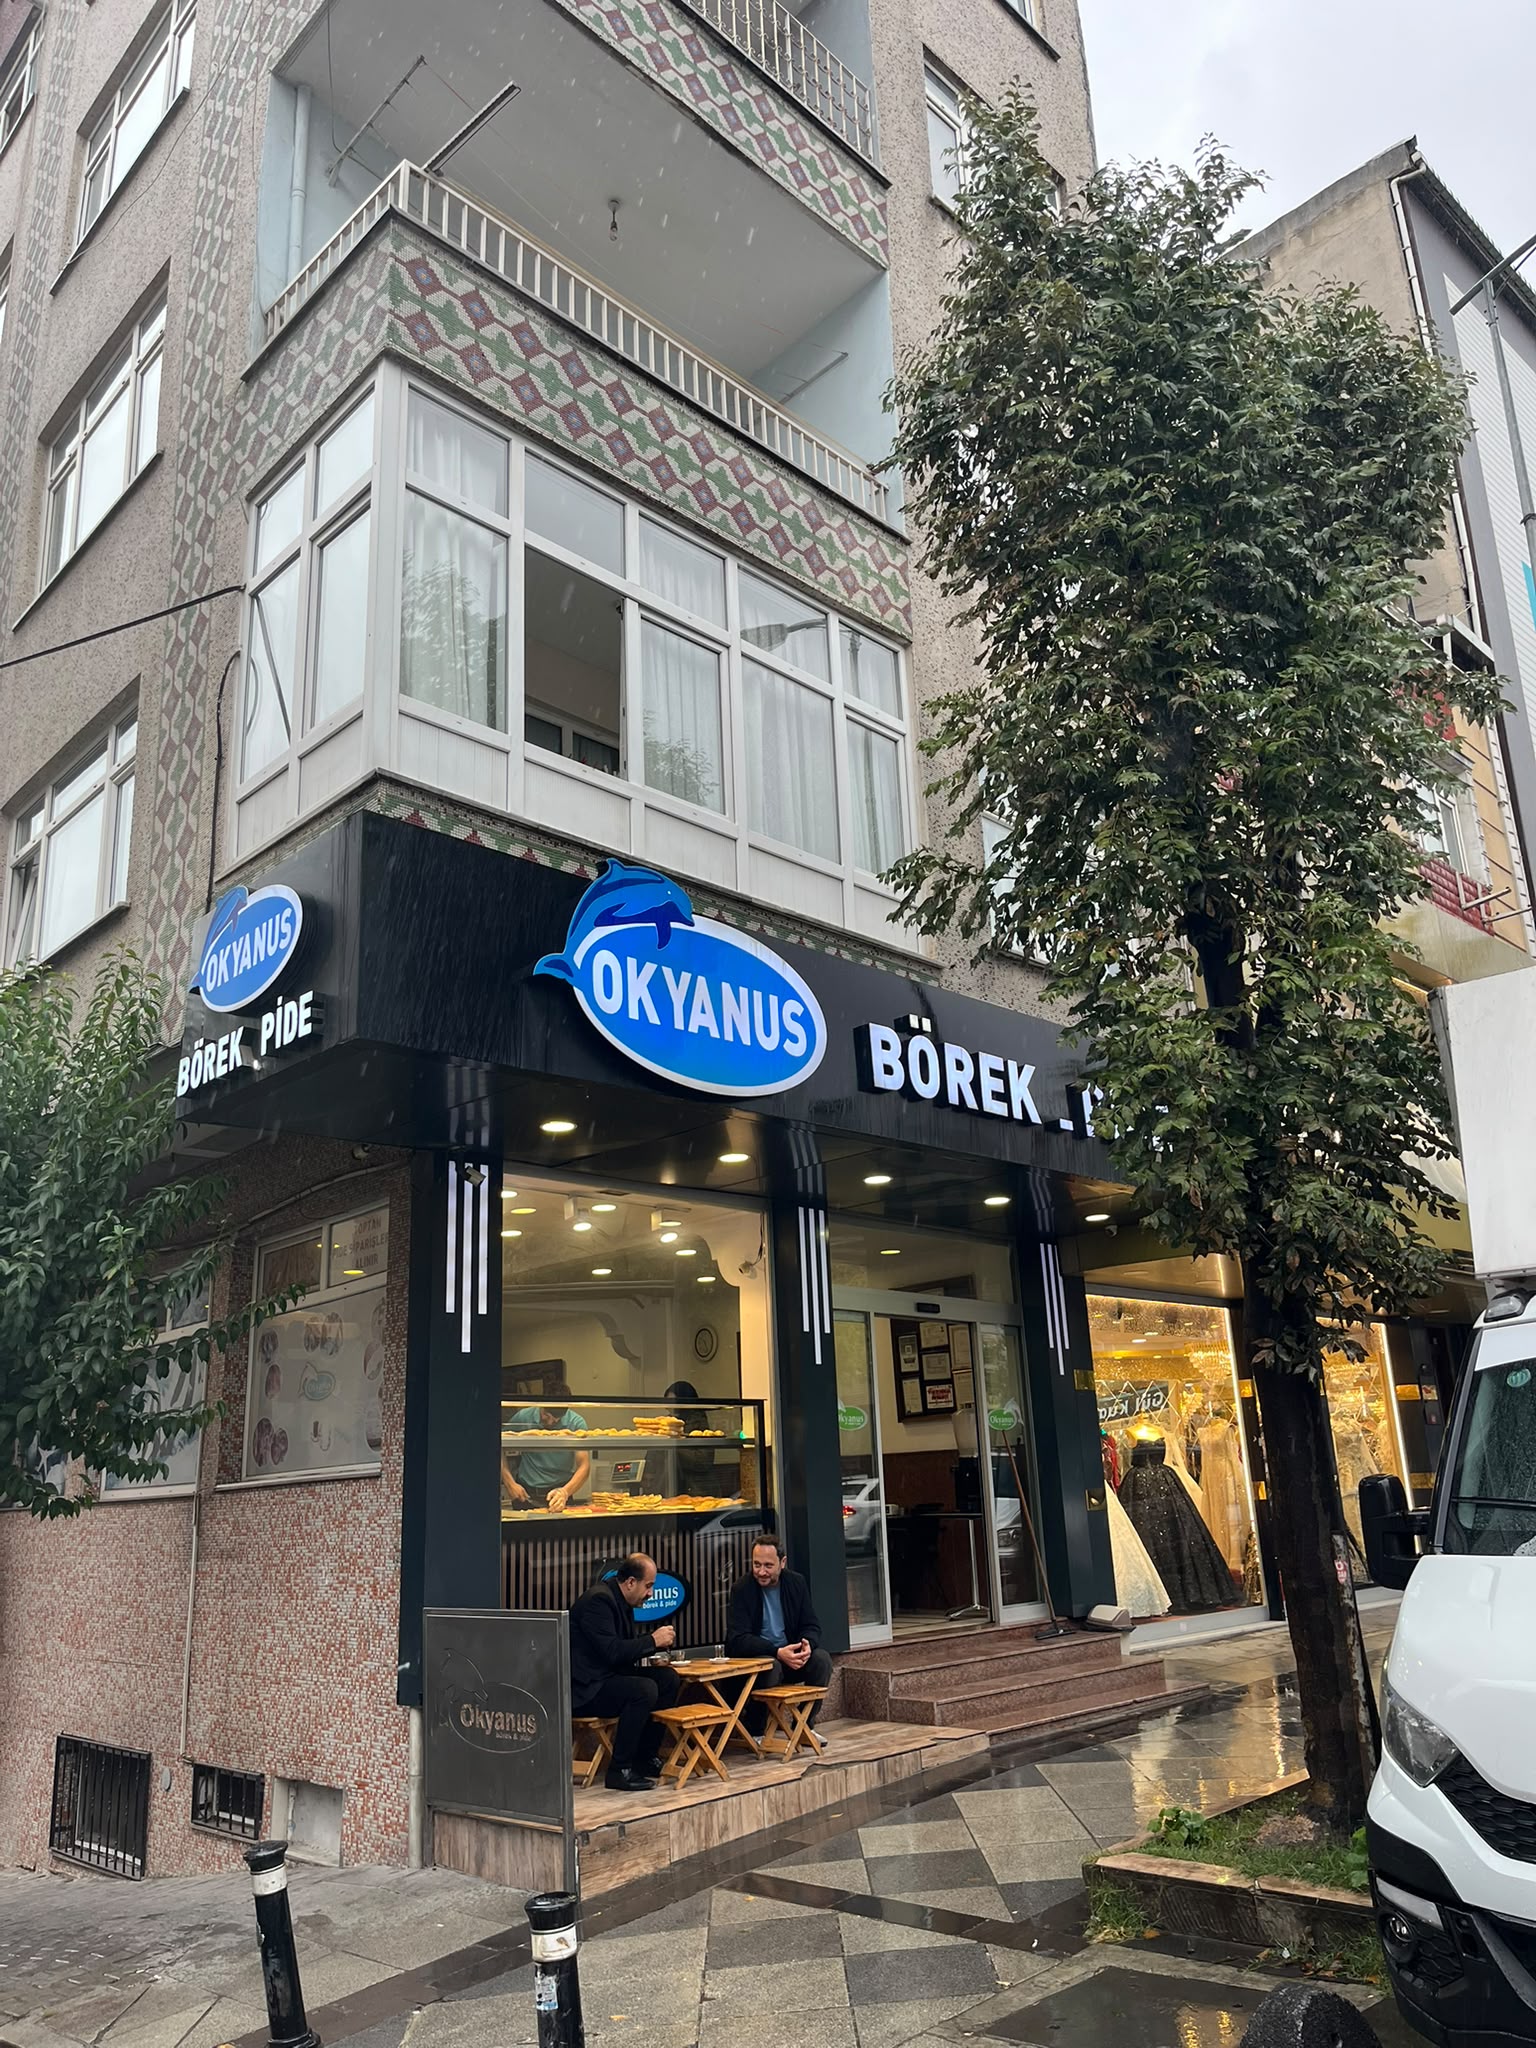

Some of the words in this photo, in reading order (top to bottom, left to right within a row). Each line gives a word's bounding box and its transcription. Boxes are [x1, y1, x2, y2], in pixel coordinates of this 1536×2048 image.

[206, 906, 293, 991] OKYANUS
[592, 948, 805, 1058] OKYANUS
[176, 1025, 246, 1098] BÖREK
[260, 989, 315, 1057] PİDE
[869, 1013, 1043, 1126] BÖREK
